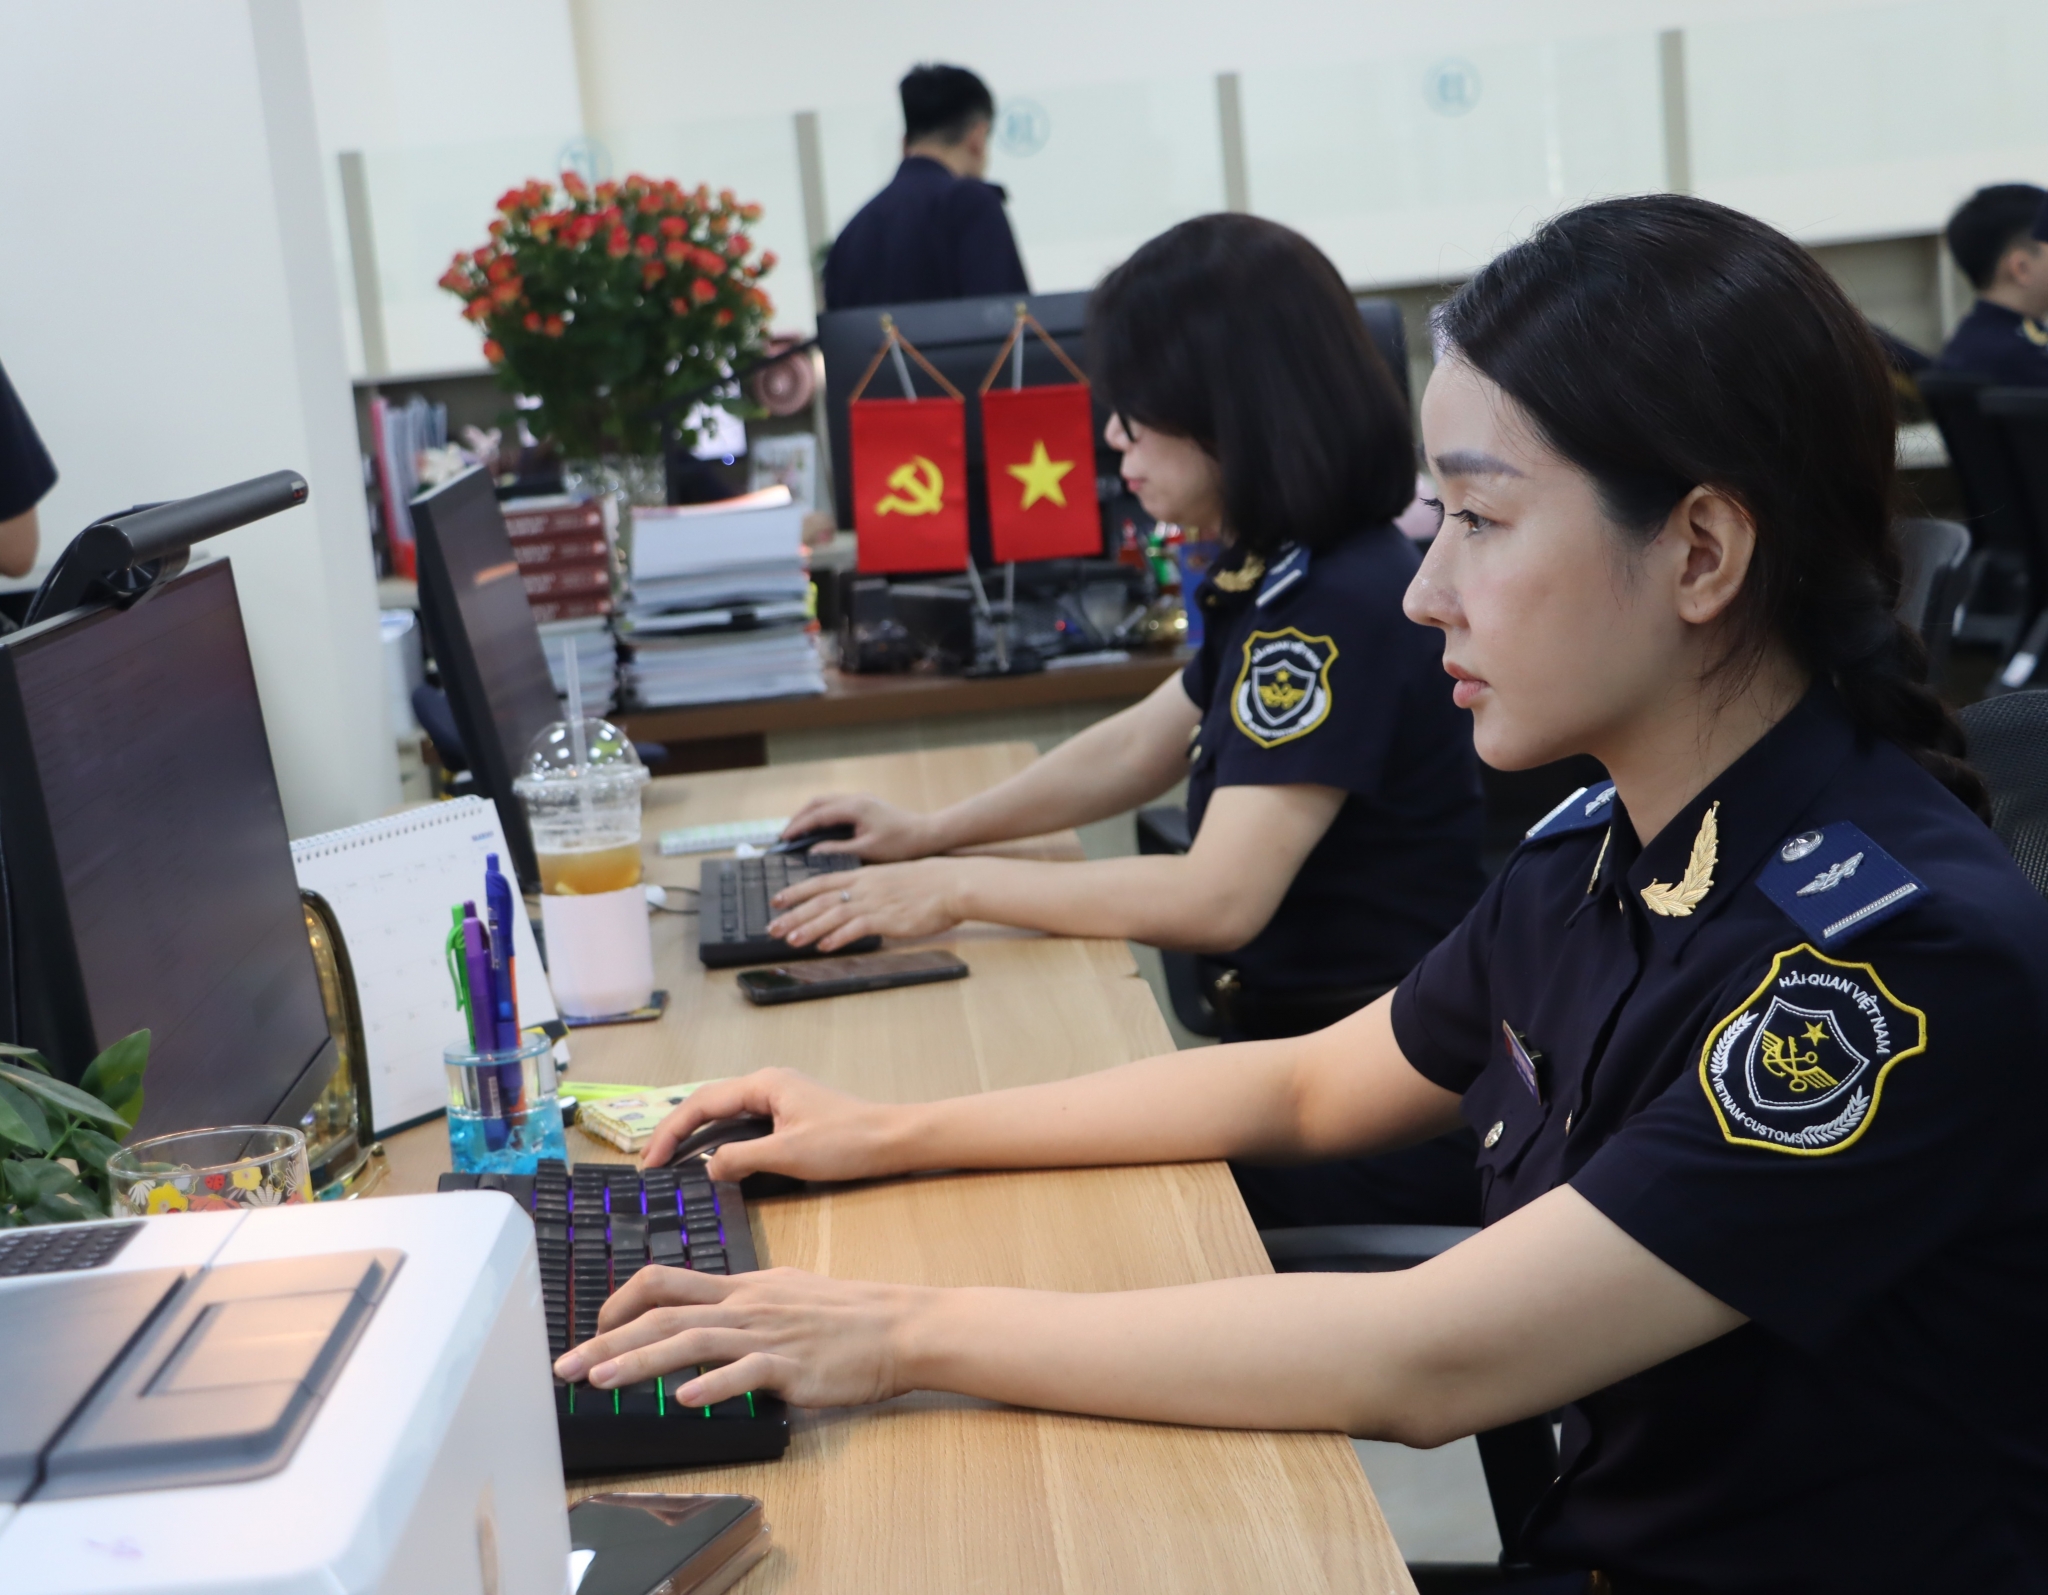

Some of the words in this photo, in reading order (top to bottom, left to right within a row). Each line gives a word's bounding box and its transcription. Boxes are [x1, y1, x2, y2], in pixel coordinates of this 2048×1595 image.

[1779, 970, 1806, 987] HẢI
[1808, 973, 1853, 994] QUAN
[1852, 985, 1880, 1015] VIỆT
[1870, 1016, 1890, 1054] NAM
[1712, 1073, 1746, 1120] VIETNAM
[1744, 1117, 1802, 1143] CUSTOMS
